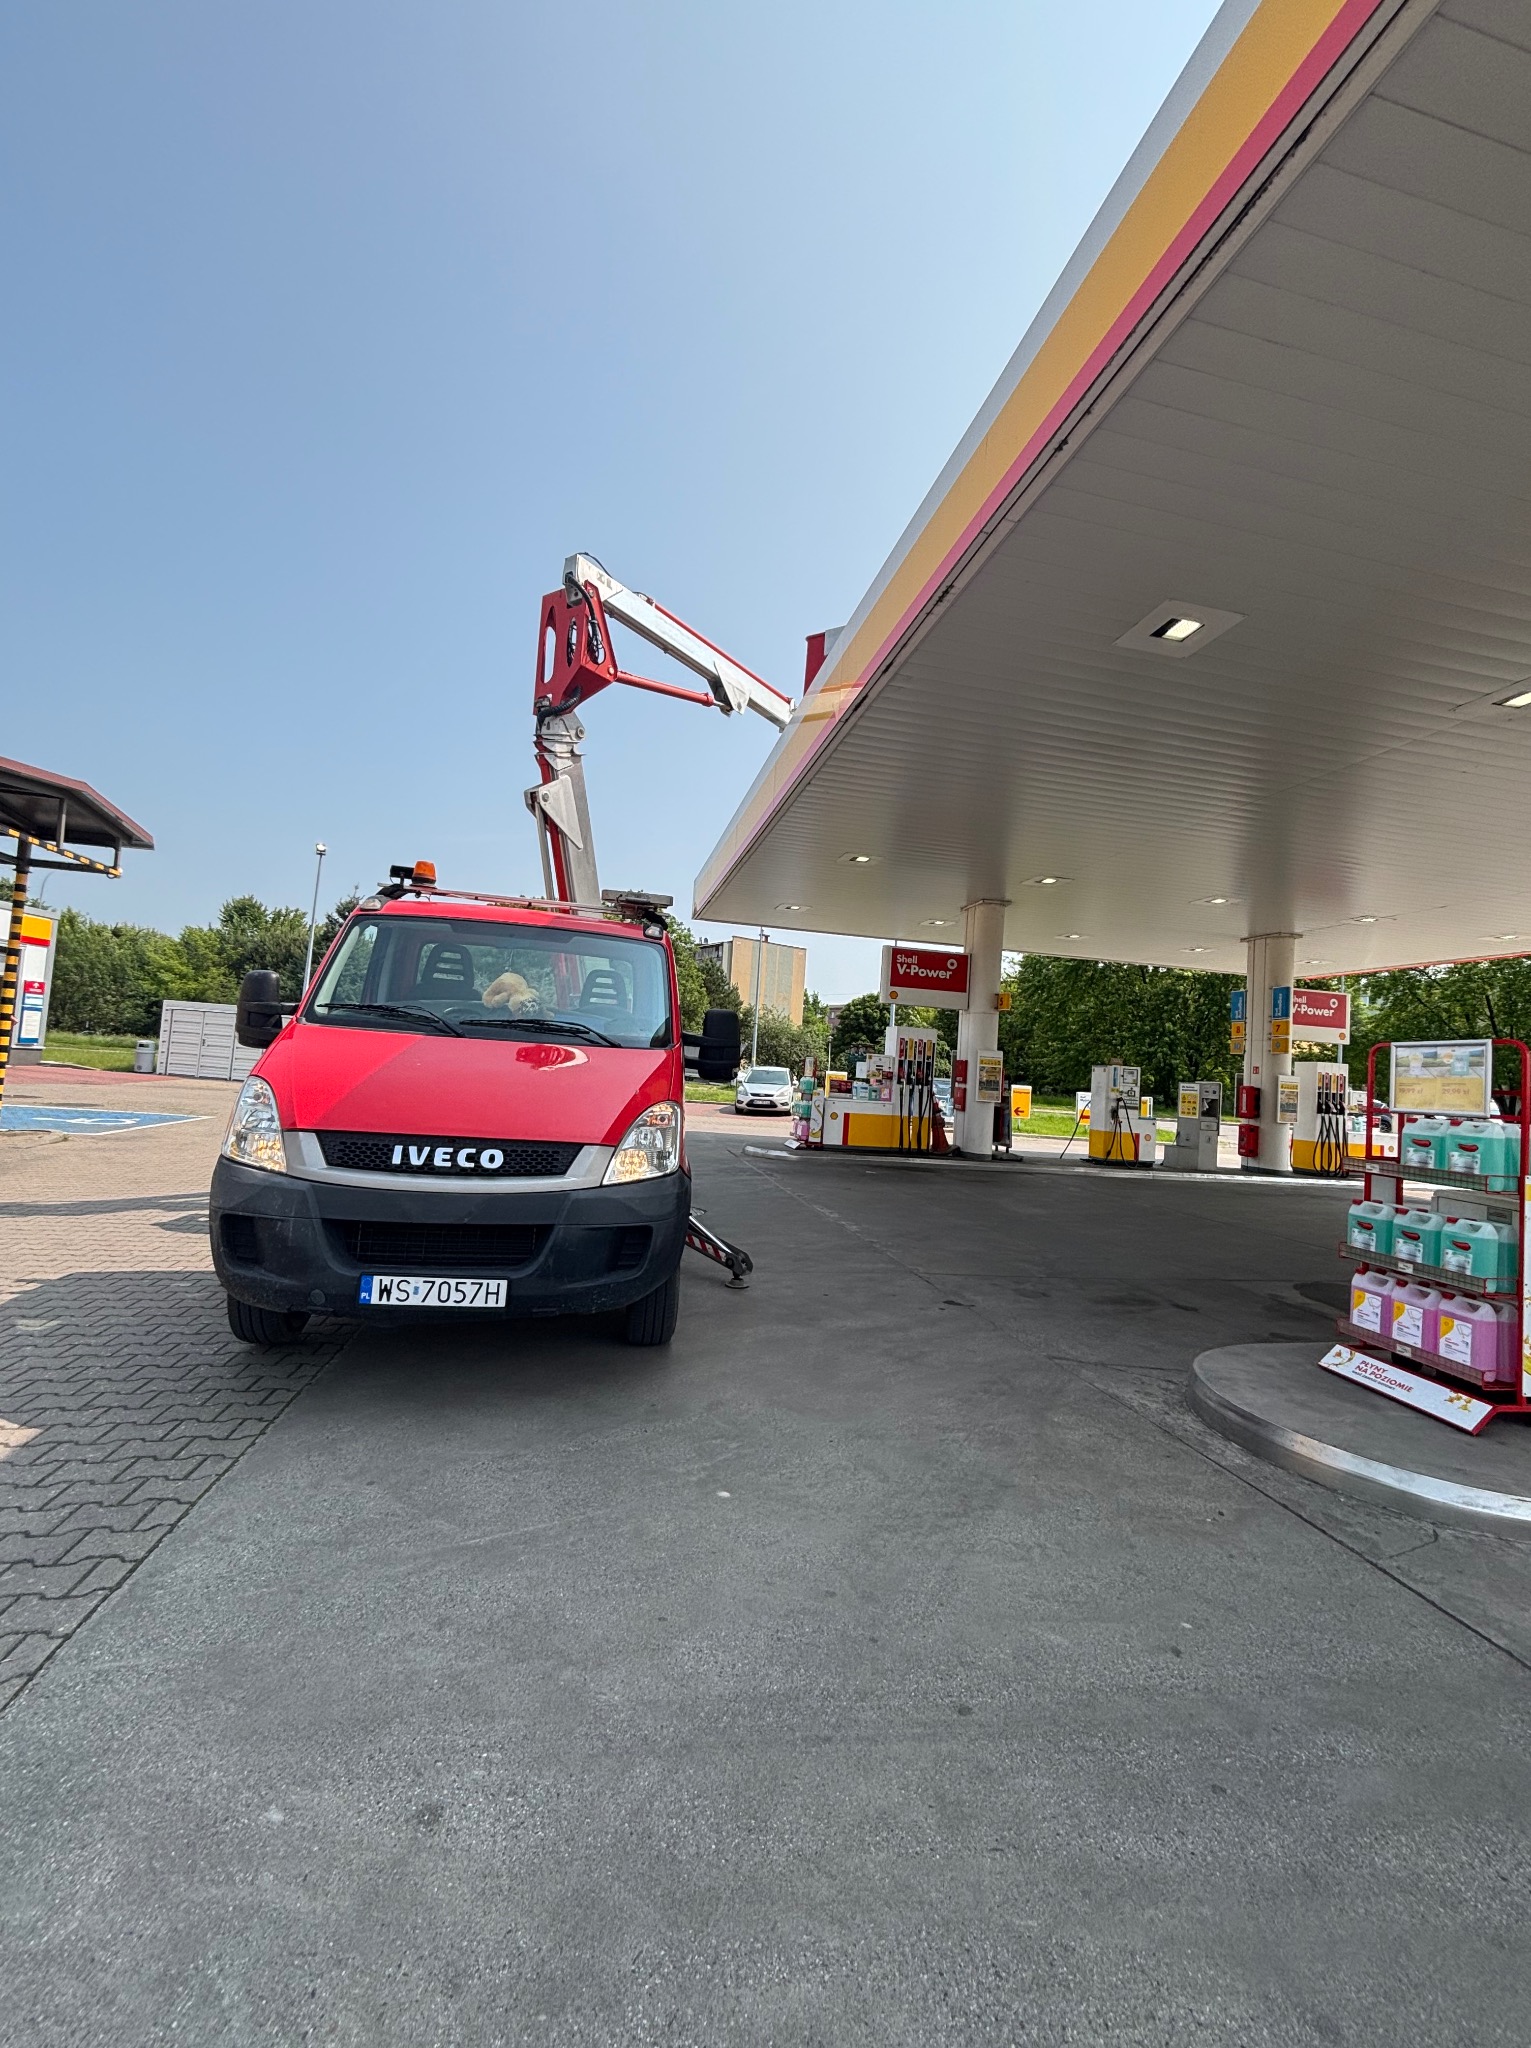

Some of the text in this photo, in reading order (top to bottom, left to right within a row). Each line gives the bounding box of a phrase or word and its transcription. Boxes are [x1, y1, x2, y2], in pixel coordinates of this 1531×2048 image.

[896, 954, 918, 964] Shell
[897, 963, 952, 979] V-Power
[1275, 1024, 1281, 1032] 7
[391, 1144, 504, 1169] IVECO
[360, 1292, 371, 1300] PL
[378, 1278, 501, 1305] WS 7057H
[1360, 1360, 1388, 1374] PŁYNY
[1354, 1365, 1369, 1374] NA
[1369, 1370, 1414, 1393] POZIOMIE
